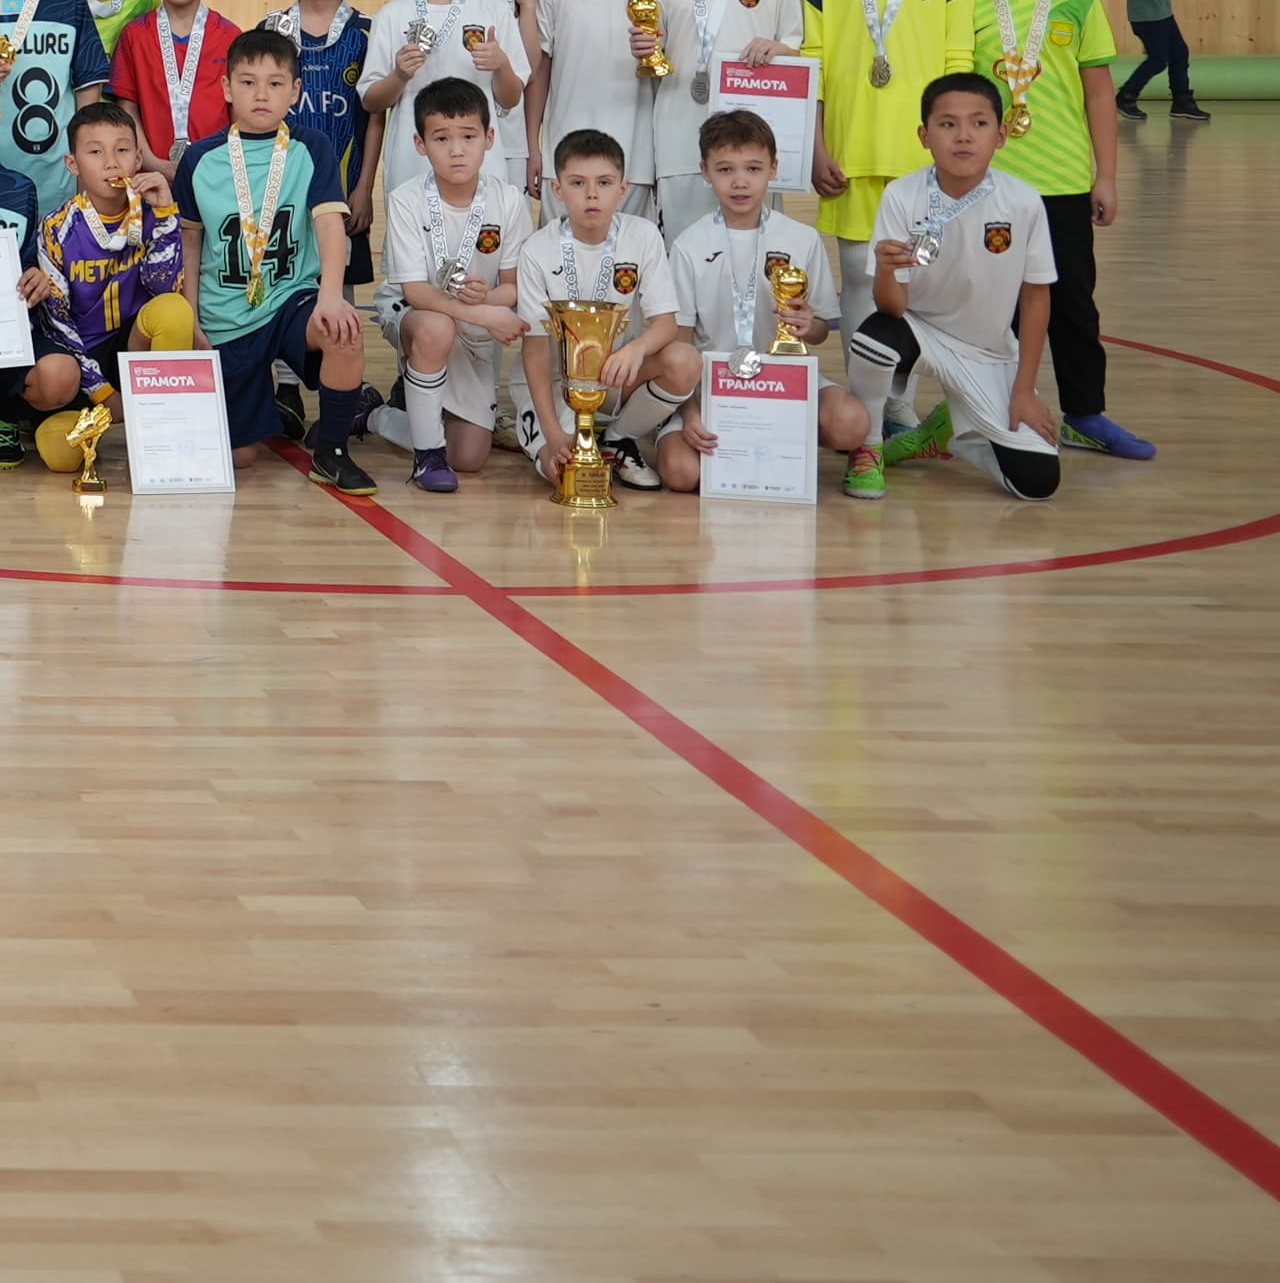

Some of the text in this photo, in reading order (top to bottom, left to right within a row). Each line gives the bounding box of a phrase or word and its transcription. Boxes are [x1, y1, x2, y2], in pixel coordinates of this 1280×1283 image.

[726, 77, 788, 91] ГРАМОТА
[288, 91, 348, 117] AFD
[219, 204, 300, 288] 14
[563, 243, 578, 301] ZAQSTAN
[135, 376, 196, 388] ГРАМОТА
[718, 378, 785, 393] ГРАМОТА
